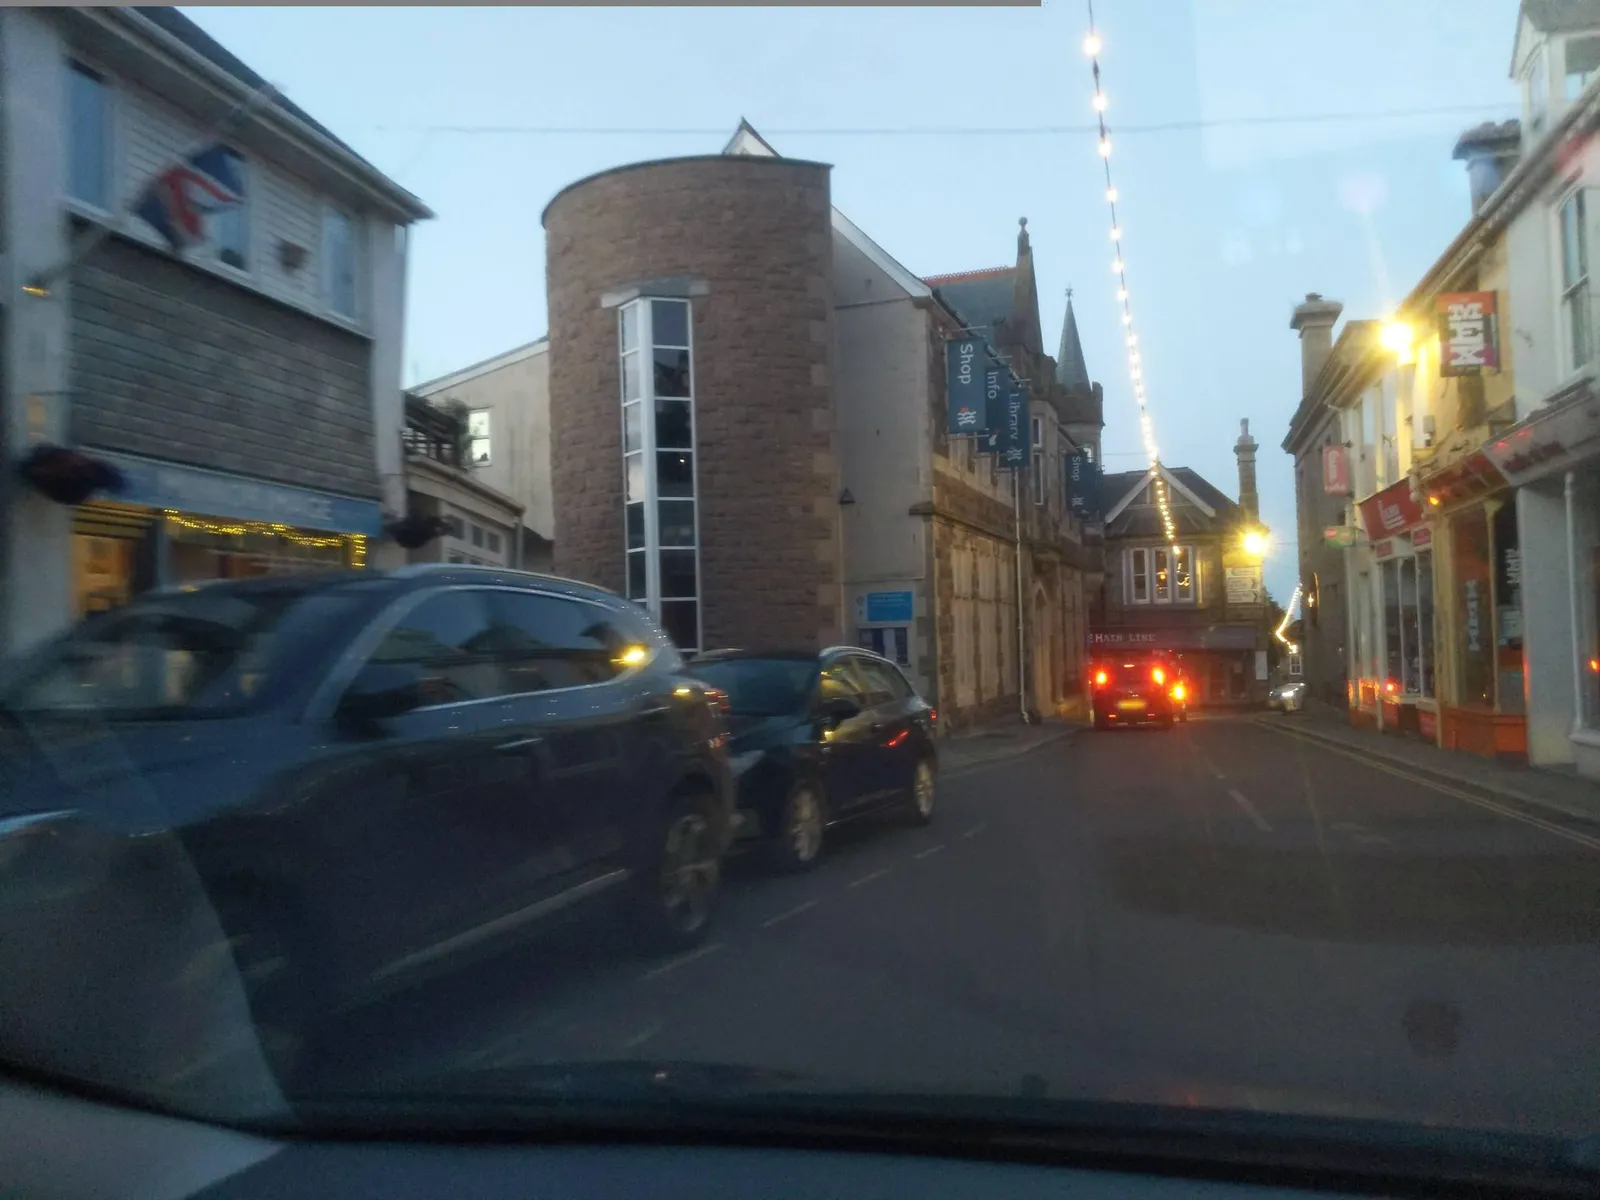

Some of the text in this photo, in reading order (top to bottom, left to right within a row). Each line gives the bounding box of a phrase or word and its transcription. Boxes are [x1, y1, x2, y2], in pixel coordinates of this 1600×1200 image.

[957, 343, 974, 384] Shop
[987, 371, 1000, 399] Info
[1007, 393, 1021, 440] Library
[1070, 455, 1082, 481] Shop
[1129, 633, 1156, 642] LINE
